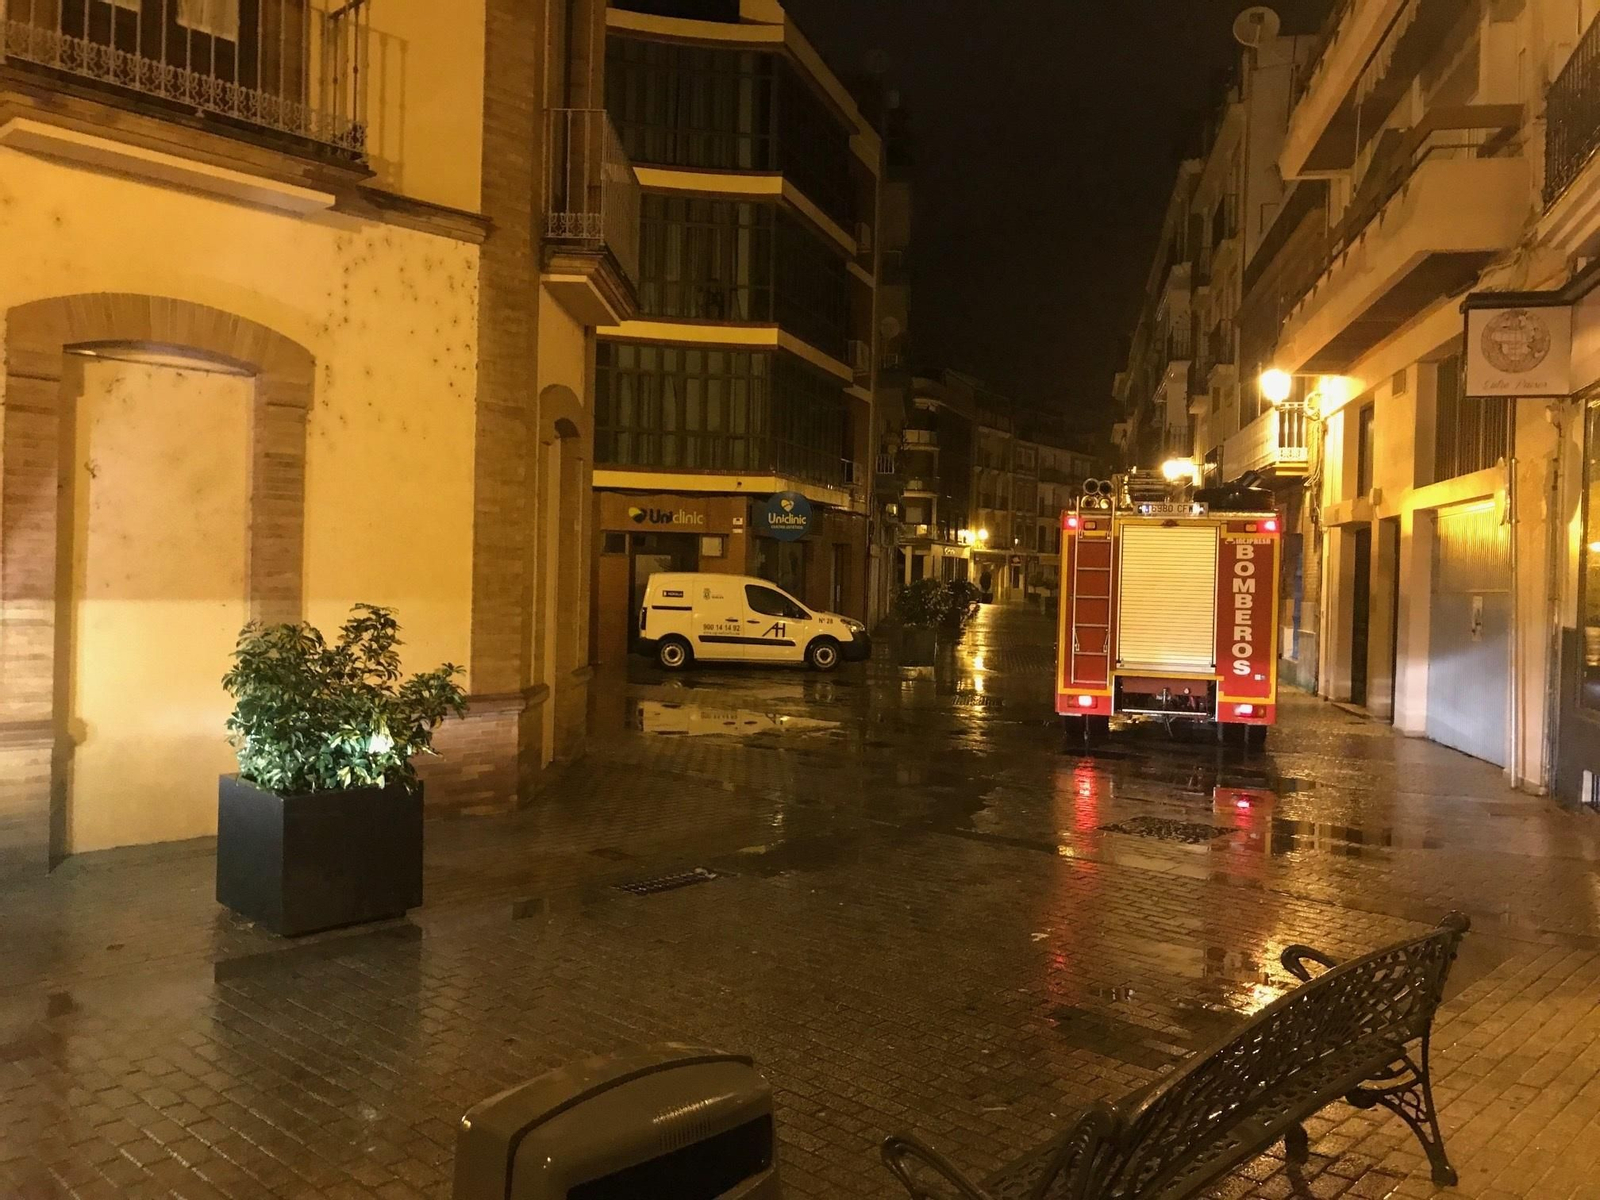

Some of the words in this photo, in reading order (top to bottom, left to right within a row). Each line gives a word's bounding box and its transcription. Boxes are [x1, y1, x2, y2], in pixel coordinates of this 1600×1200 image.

[650, 507, 703, 525] Uniclinic
[768, 512, 807, 525] Uniclinic
[1232, 544, 1256, 675] BOMBEROS
